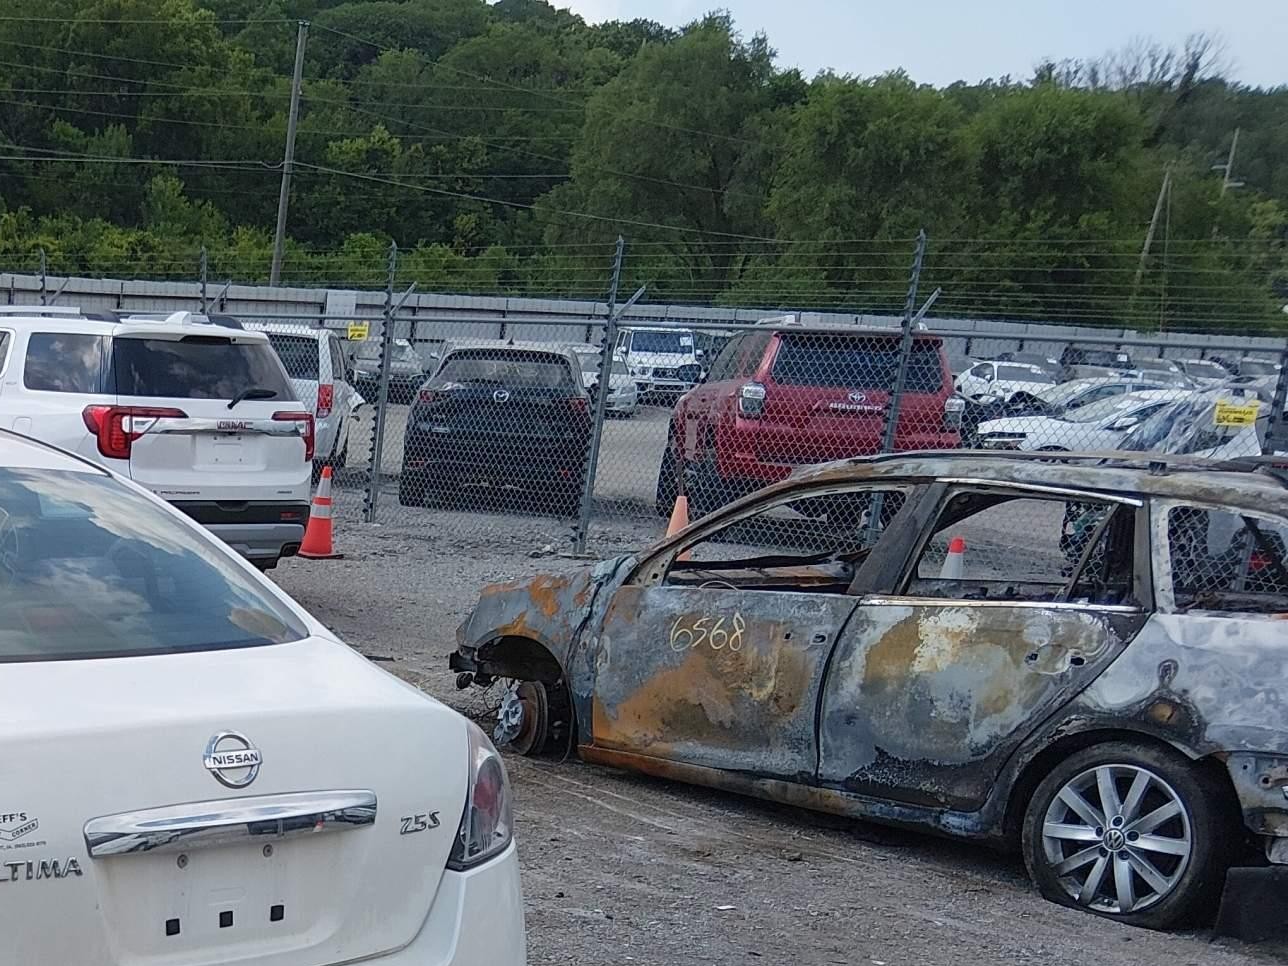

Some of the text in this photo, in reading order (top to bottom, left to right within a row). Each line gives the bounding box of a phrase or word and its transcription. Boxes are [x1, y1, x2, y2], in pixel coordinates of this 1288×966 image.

[670, 612, 746, 652] 6568
[212, 752, 259, 765] NISSAN
[12, 822, 36, 838] CORNER
